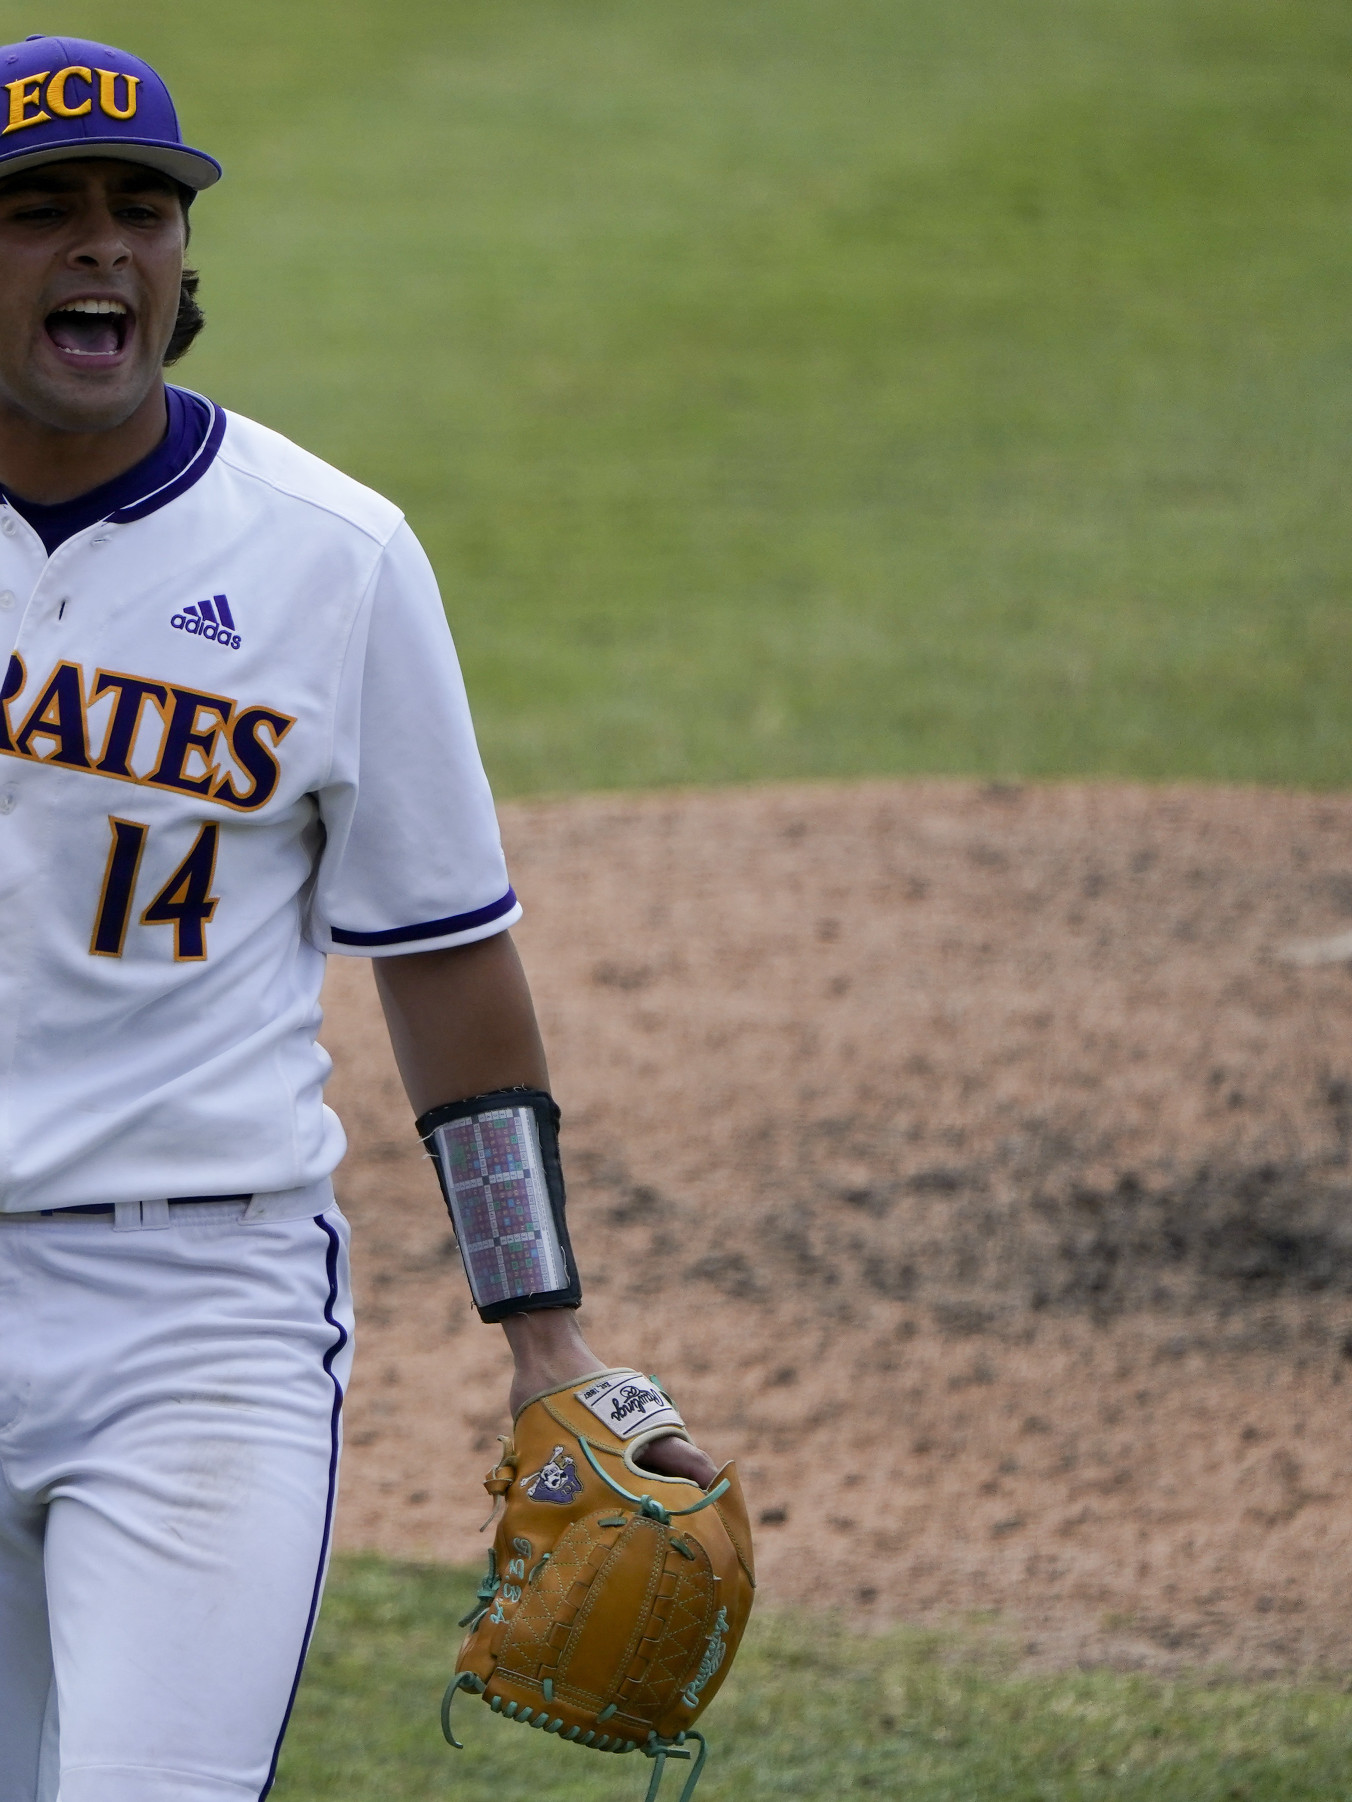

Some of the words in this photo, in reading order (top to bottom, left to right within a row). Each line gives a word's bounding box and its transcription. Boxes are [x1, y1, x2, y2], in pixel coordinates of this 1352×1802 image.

[2, 66, 142, 135] ECU
[170, 614, 242, 650] adidas
[89, 815, 221, 962] 14
[611, 1388, 665, 1421] Rawlings
